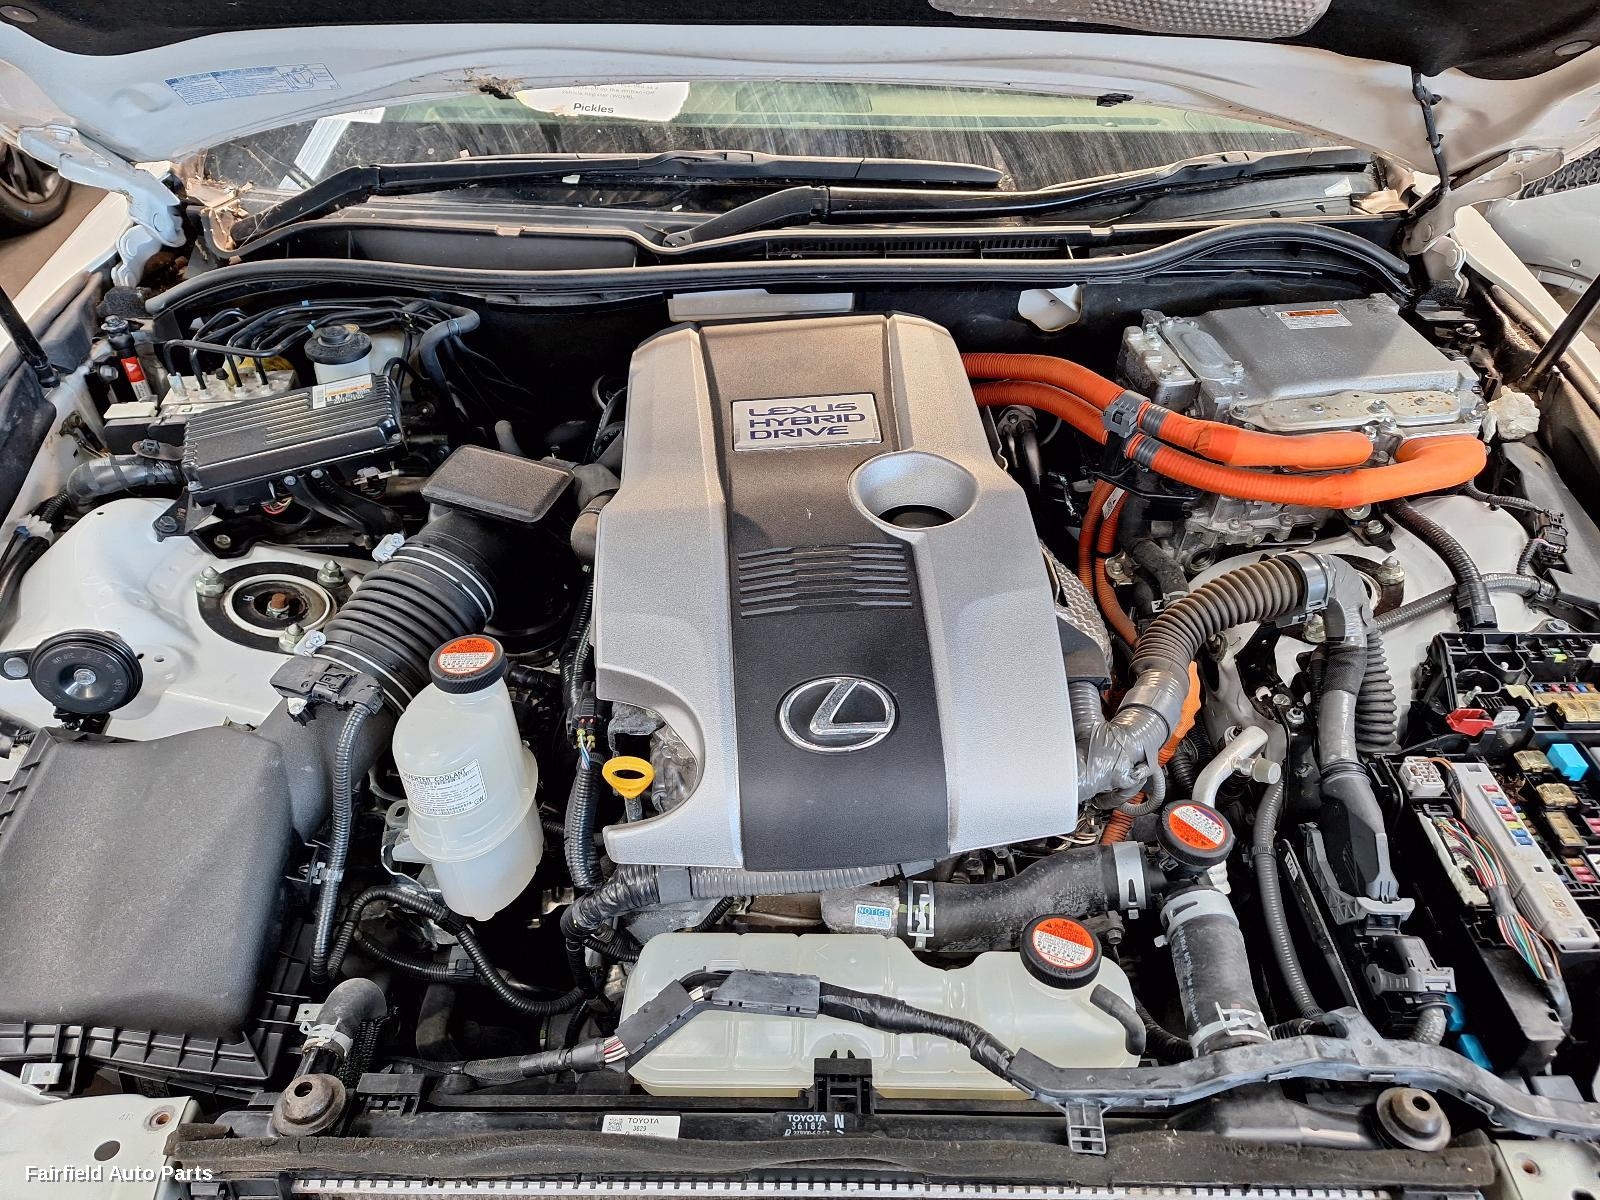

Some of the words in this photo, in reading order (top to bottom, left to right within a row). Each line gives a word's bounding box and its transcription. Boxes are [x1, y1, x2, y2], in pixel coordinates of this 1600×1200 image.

[573, 102, 615, 114] Pickles
[748, 402, 857, 416] LEXUS
[749, 413, 866, 428] HYBRID
[749, 425, 849, 440] DRIVE
[434, 768, 466, 782] COOLANT
[858, 907, 890, 917] NOTICE
[787, 1114, 828, 1122] TOYOTA
[791, 1122, 822, 1130] 36182
